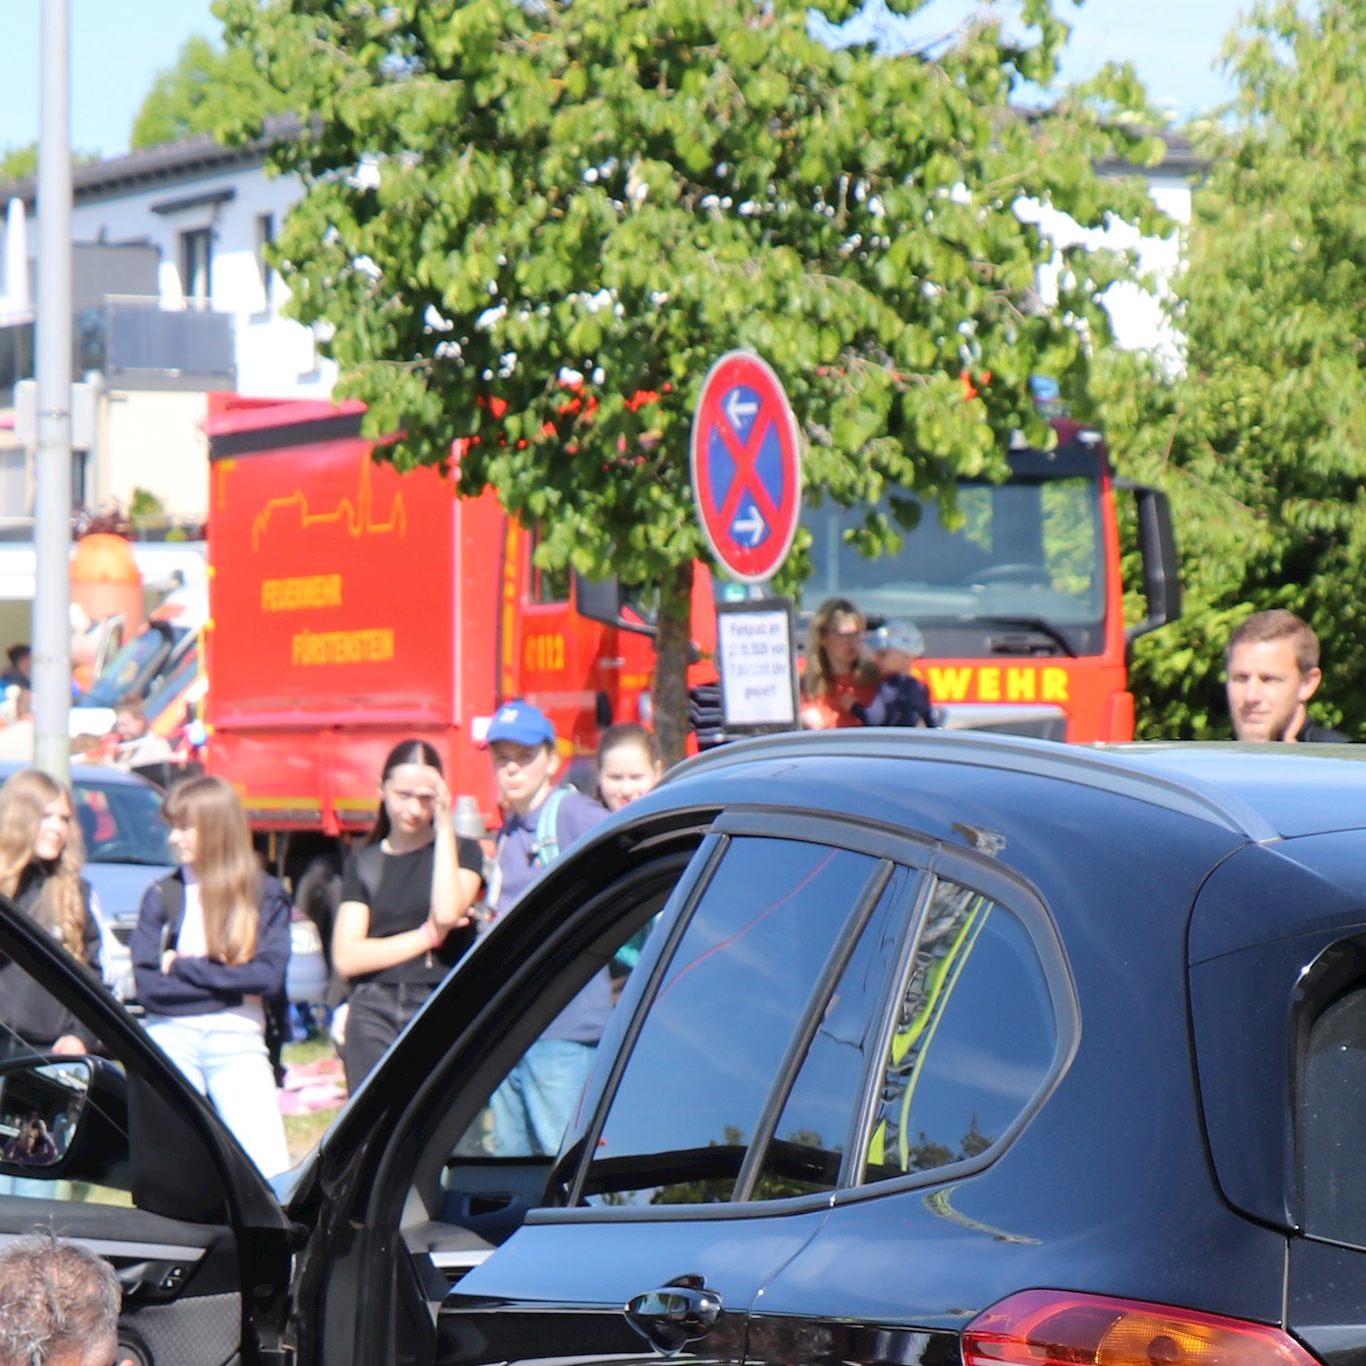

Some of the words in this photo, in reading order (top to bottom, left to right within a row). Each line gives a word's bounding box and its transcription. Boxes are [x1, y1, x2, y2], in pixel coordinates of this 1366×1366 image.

[261, 573, 343, 612] FEUERWEHR
[539, 633, 565, 670] 112
[911, 666, 1070, 701] WEHR
